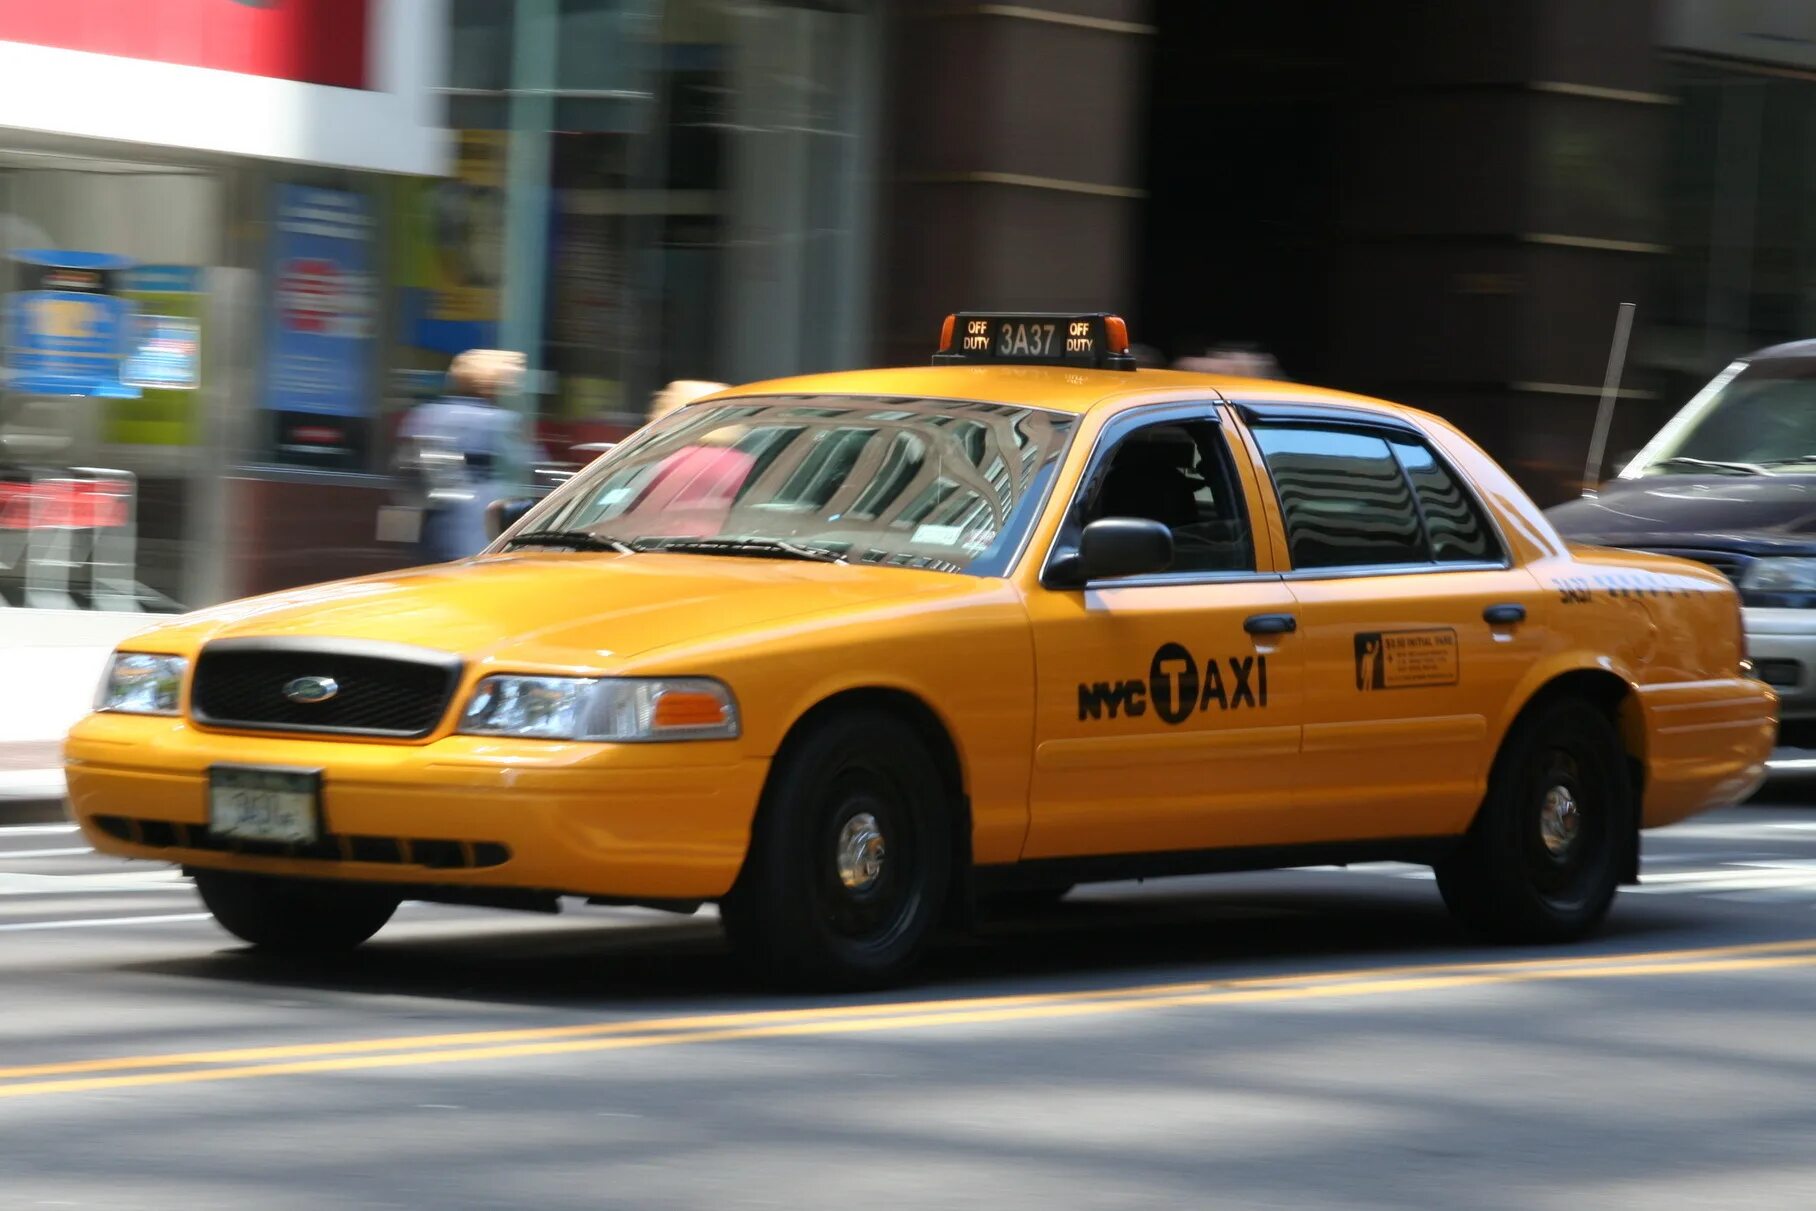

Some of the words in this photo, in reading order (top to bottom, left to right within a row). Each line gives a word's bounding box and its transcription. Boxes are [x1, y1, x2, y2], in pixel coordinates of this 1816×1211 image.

[968, 321, 988, 334] OFF
[1069, 322, 1090, 336] OFF
[963, 336, 990, 350] DUTY
[1001, 323, 1055, 356] 3A37
[1066, 338, 1093, 352] DUTY
[1078, 679, 1146, 721] NYC
[1150, 642, 1267, 724] TAXI
